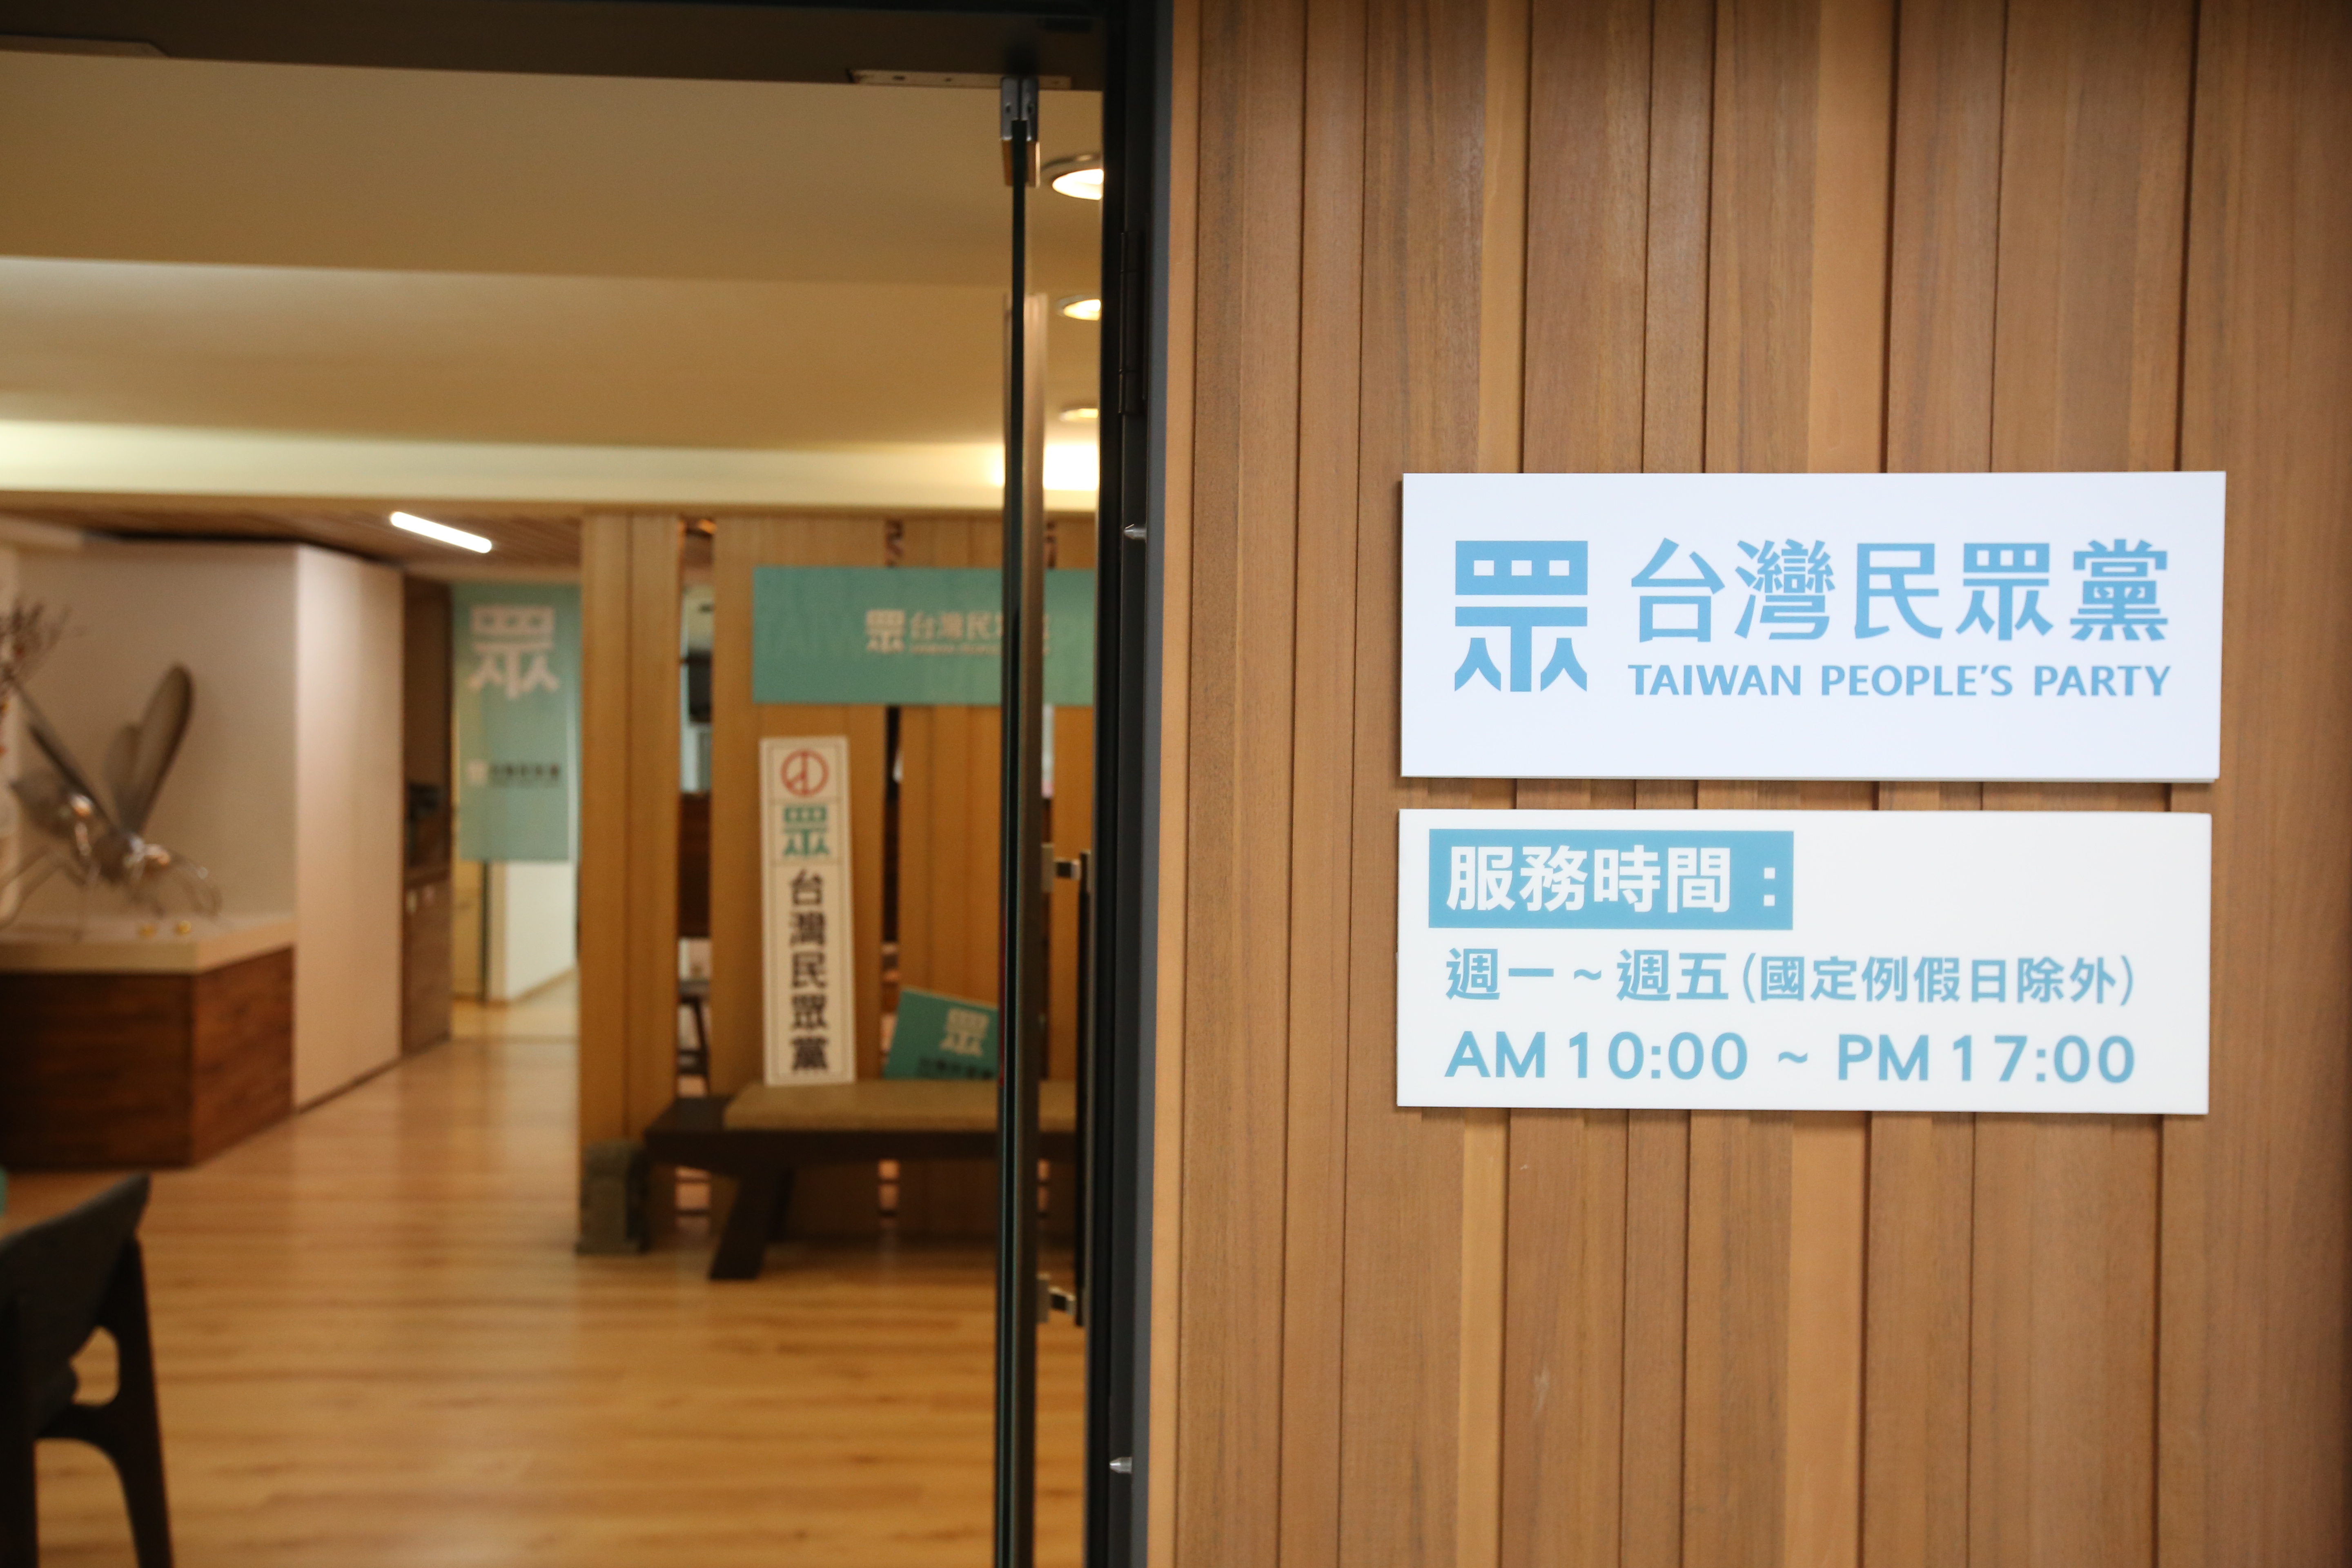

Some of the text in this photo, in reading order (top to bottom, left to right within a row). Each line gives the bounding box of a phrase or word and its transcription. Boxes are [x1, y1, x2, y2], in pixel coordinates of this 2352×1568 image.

[1455, 541, 1588, 692] 眾
[1631, 538, 2169, 643] 台灣民眾黨
[1628, 665, 2170, 697] TAIWAN PEOPLE'S PARTY
[1446, 1031, 1545, 1078] AM
[1570, 1031, 1747, 1080] 10:00
[1839, 1034, 1929, 1080] PM
[1954, 1036, 2134, 1083] 17:00
